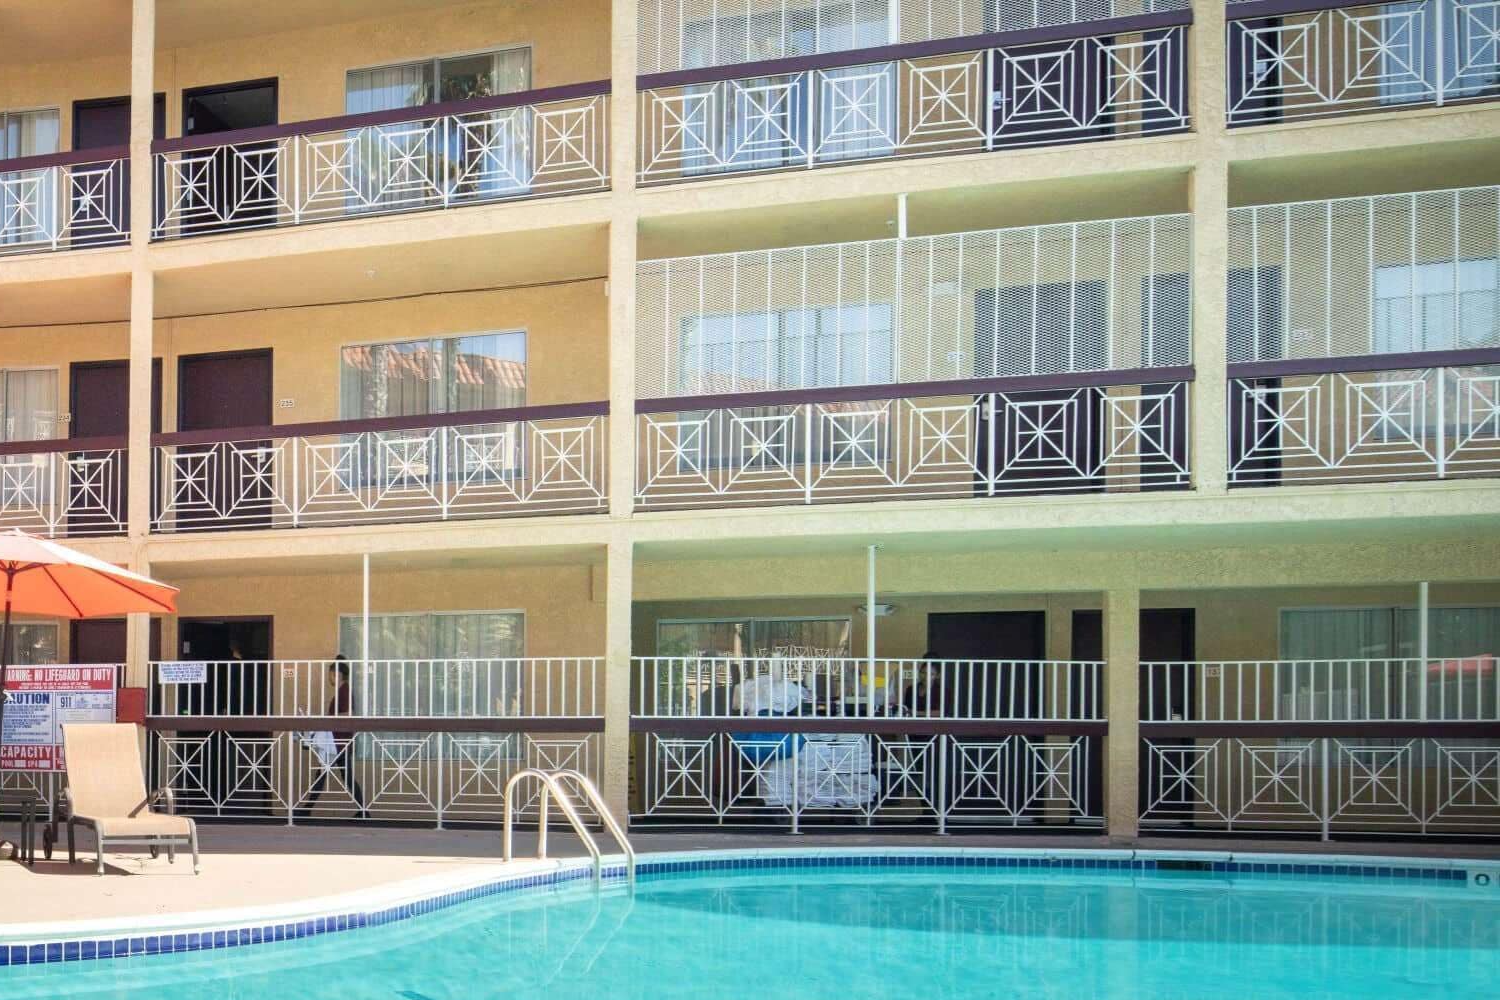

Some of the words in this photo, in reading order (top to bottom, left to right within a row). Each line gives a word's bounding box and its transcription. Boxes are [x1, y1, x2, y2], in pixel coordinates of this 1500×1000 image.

[34, 669, 43, 681] NO
[45, 669, 80, 681] LIFEGUARD
[82, 669, 91, 681] ON
[93, 669, 111, 680] DUTY
[60, 696, 72, 707] 911
[0, 746, 51, 758] CAPACITY
